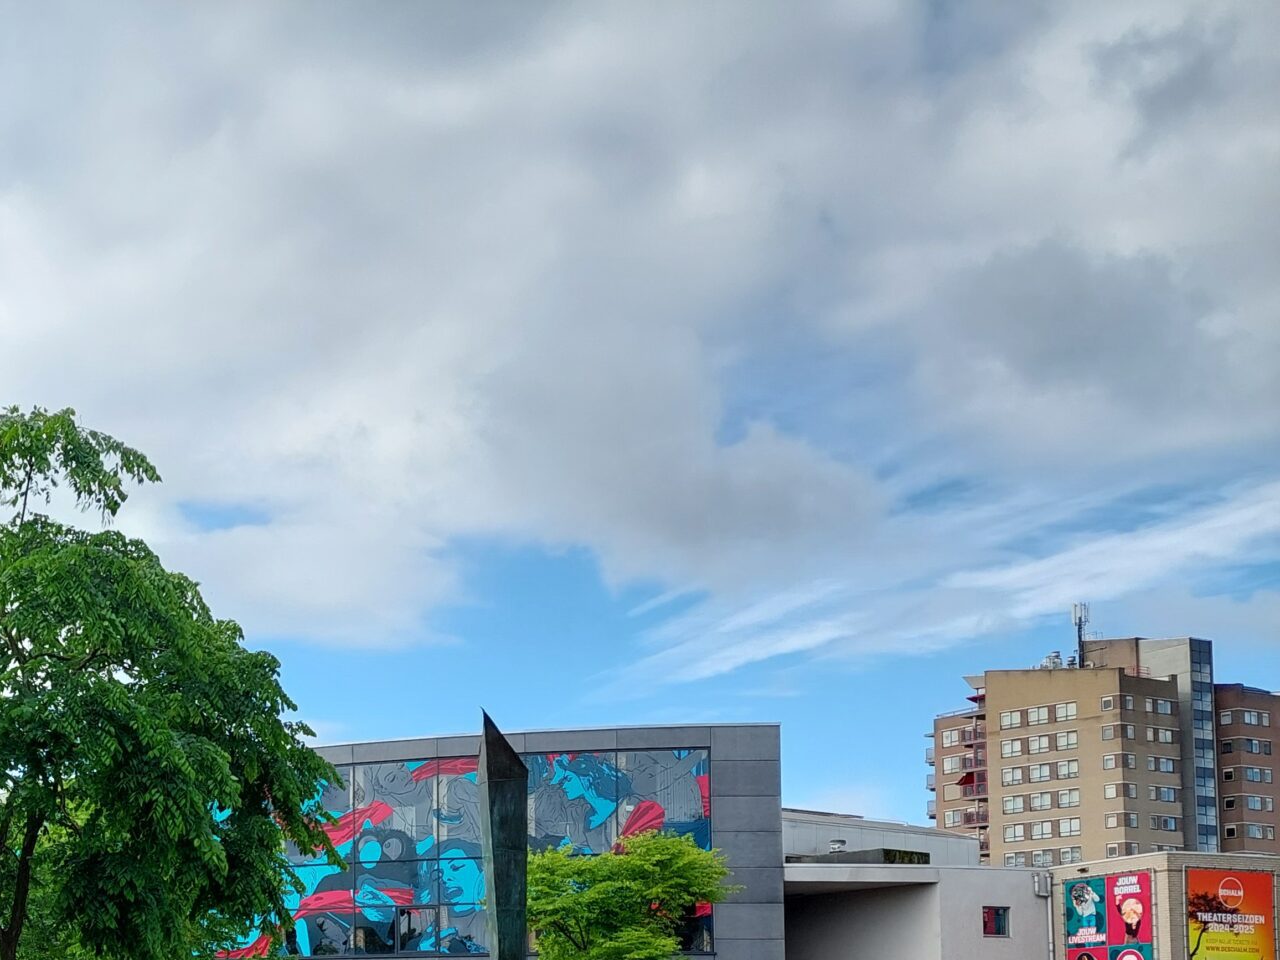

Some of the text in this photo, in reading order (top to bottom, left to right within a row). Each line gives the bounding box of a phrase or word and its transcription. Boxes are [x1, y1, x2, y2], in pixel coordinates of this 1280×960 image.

[1116, 875, 1138, 885] JOUW
[1197, 912, 1265, 924] THEATERSEIZOEN
[1077, 927, 1097, 936] JOUW
[1208, 922, 1254, 933] 2024-2025
[1068, 933, 1106, 944] LIVESTREAM
